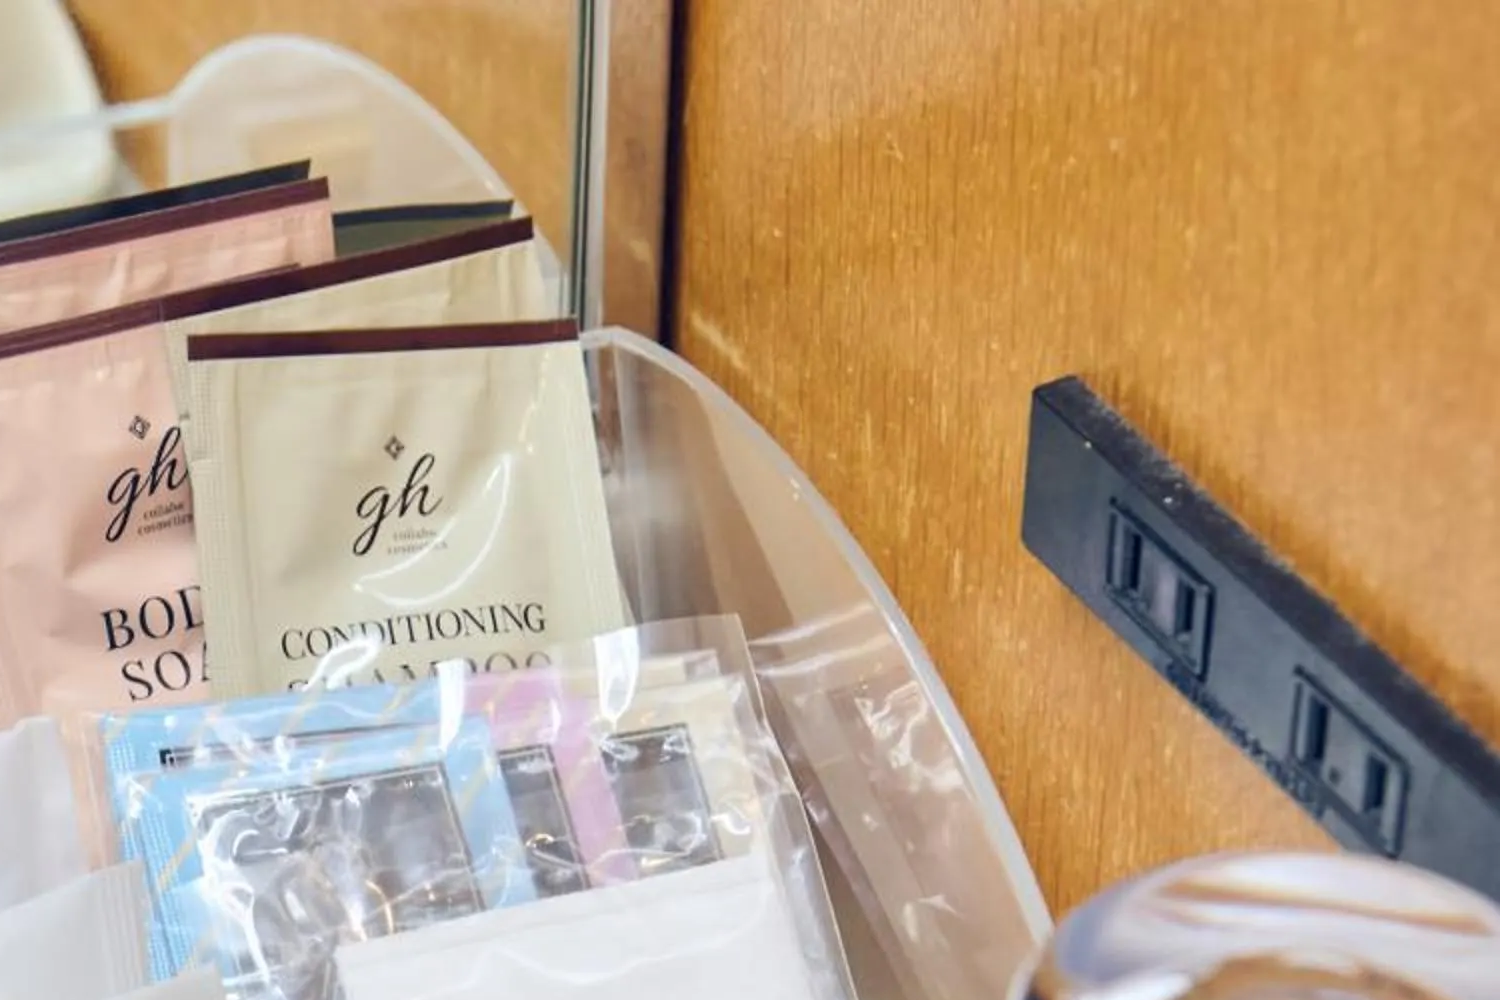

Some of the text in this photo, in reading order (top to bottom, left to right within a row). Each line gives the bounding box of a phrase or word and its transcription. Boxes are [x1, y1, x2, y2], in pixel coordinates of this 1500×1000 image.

[105, 425, 190, 543] gh
[352, 452, 444, 556] gh
[99, 584, 205, 651] BOD
[280, 602, 547, 662] CONDITIONING
[120, 640, 212, 703] SO
